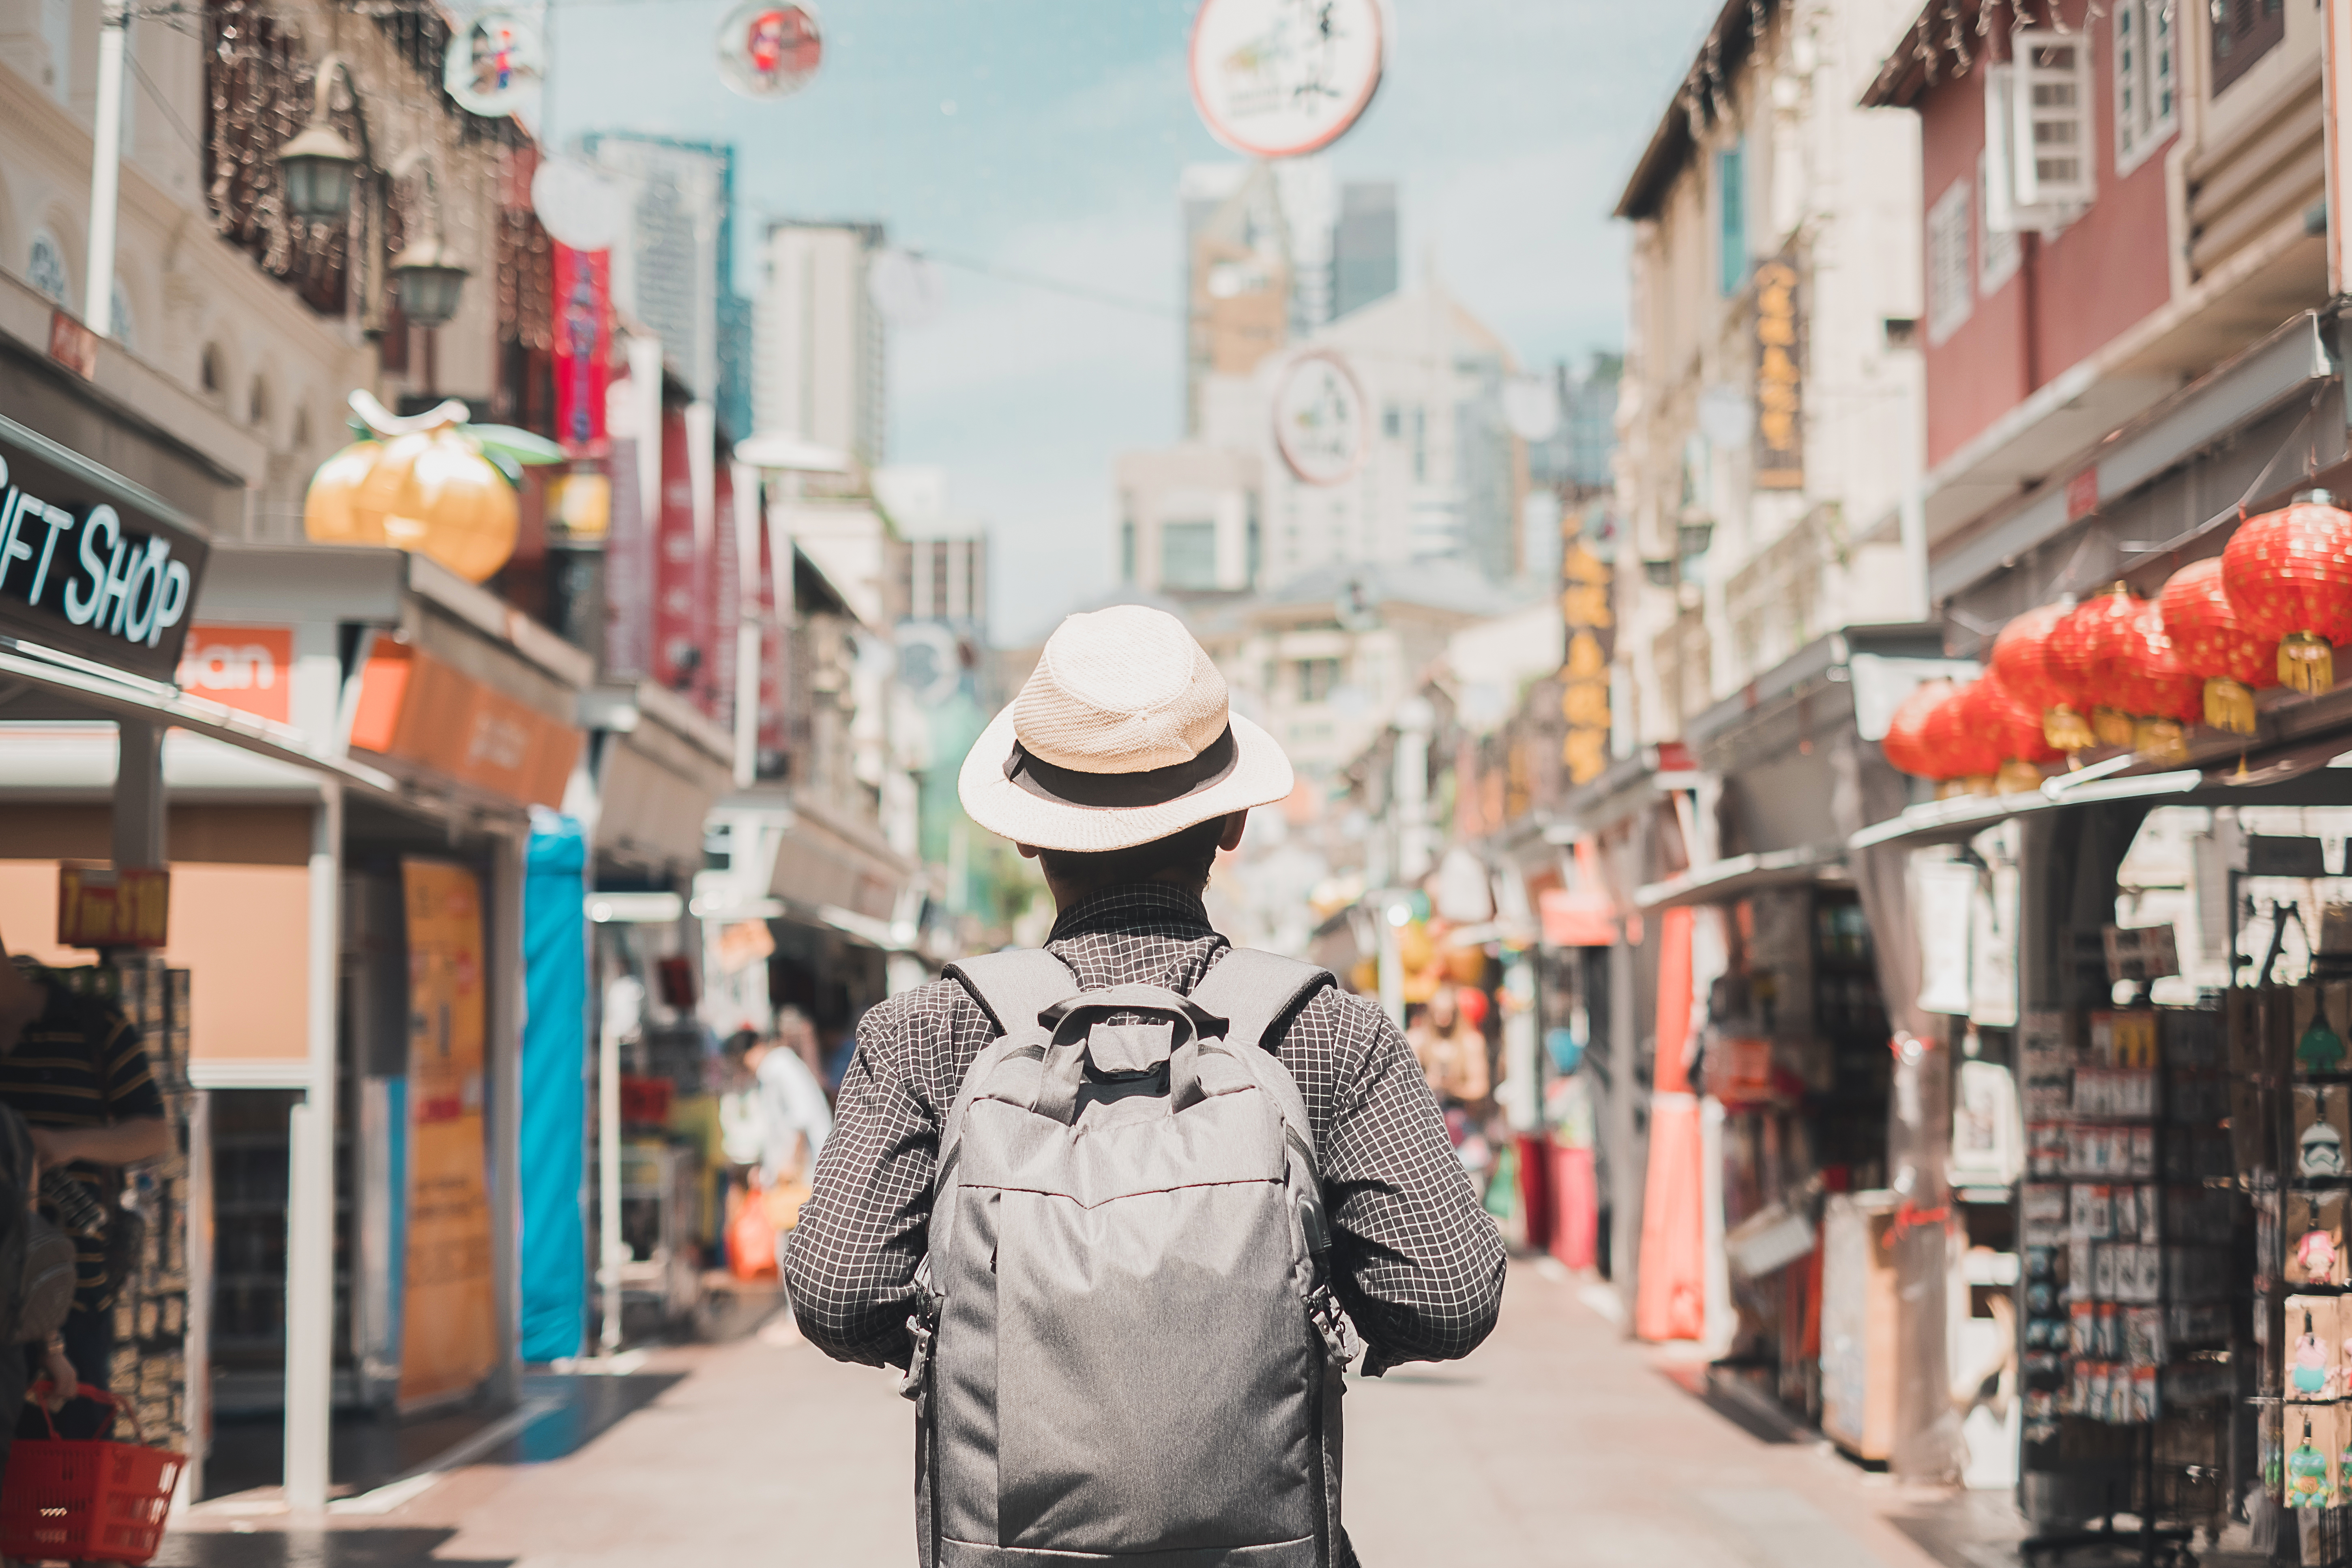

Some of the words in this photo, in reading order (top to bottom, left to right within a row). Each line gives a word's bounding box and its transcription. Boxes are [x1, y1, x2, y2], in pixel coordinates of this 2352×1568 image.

[0, 453, 76, 607] IFT
[63, 503, 191, 649] SHOP
[176, 633, 275, 690] ian
